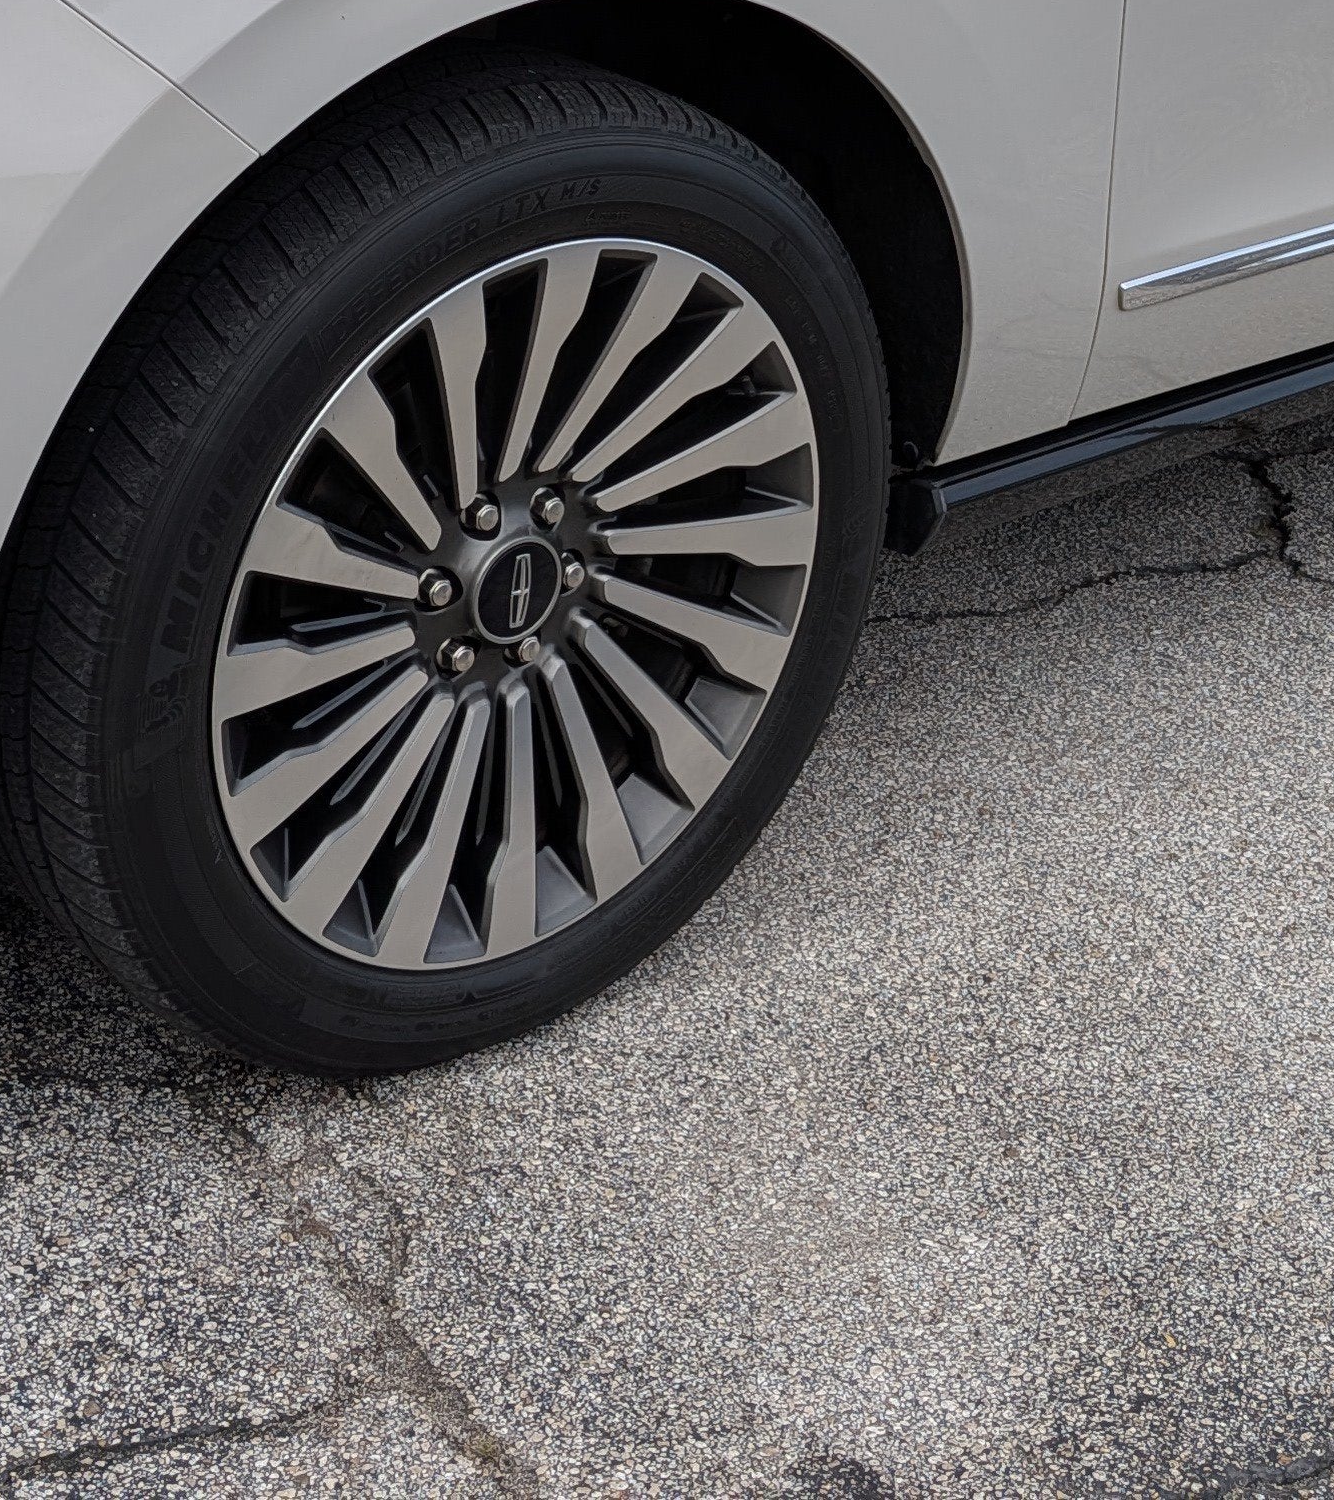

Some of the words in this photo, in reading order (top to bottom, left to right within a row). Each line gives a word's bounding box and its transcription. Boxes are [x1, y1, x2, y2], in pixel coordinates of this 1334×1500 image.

[331, 217, 482, 340] DEFENDER
[497, 187, 551, 225] LTX
[560, 178, 602, 201] M/S
